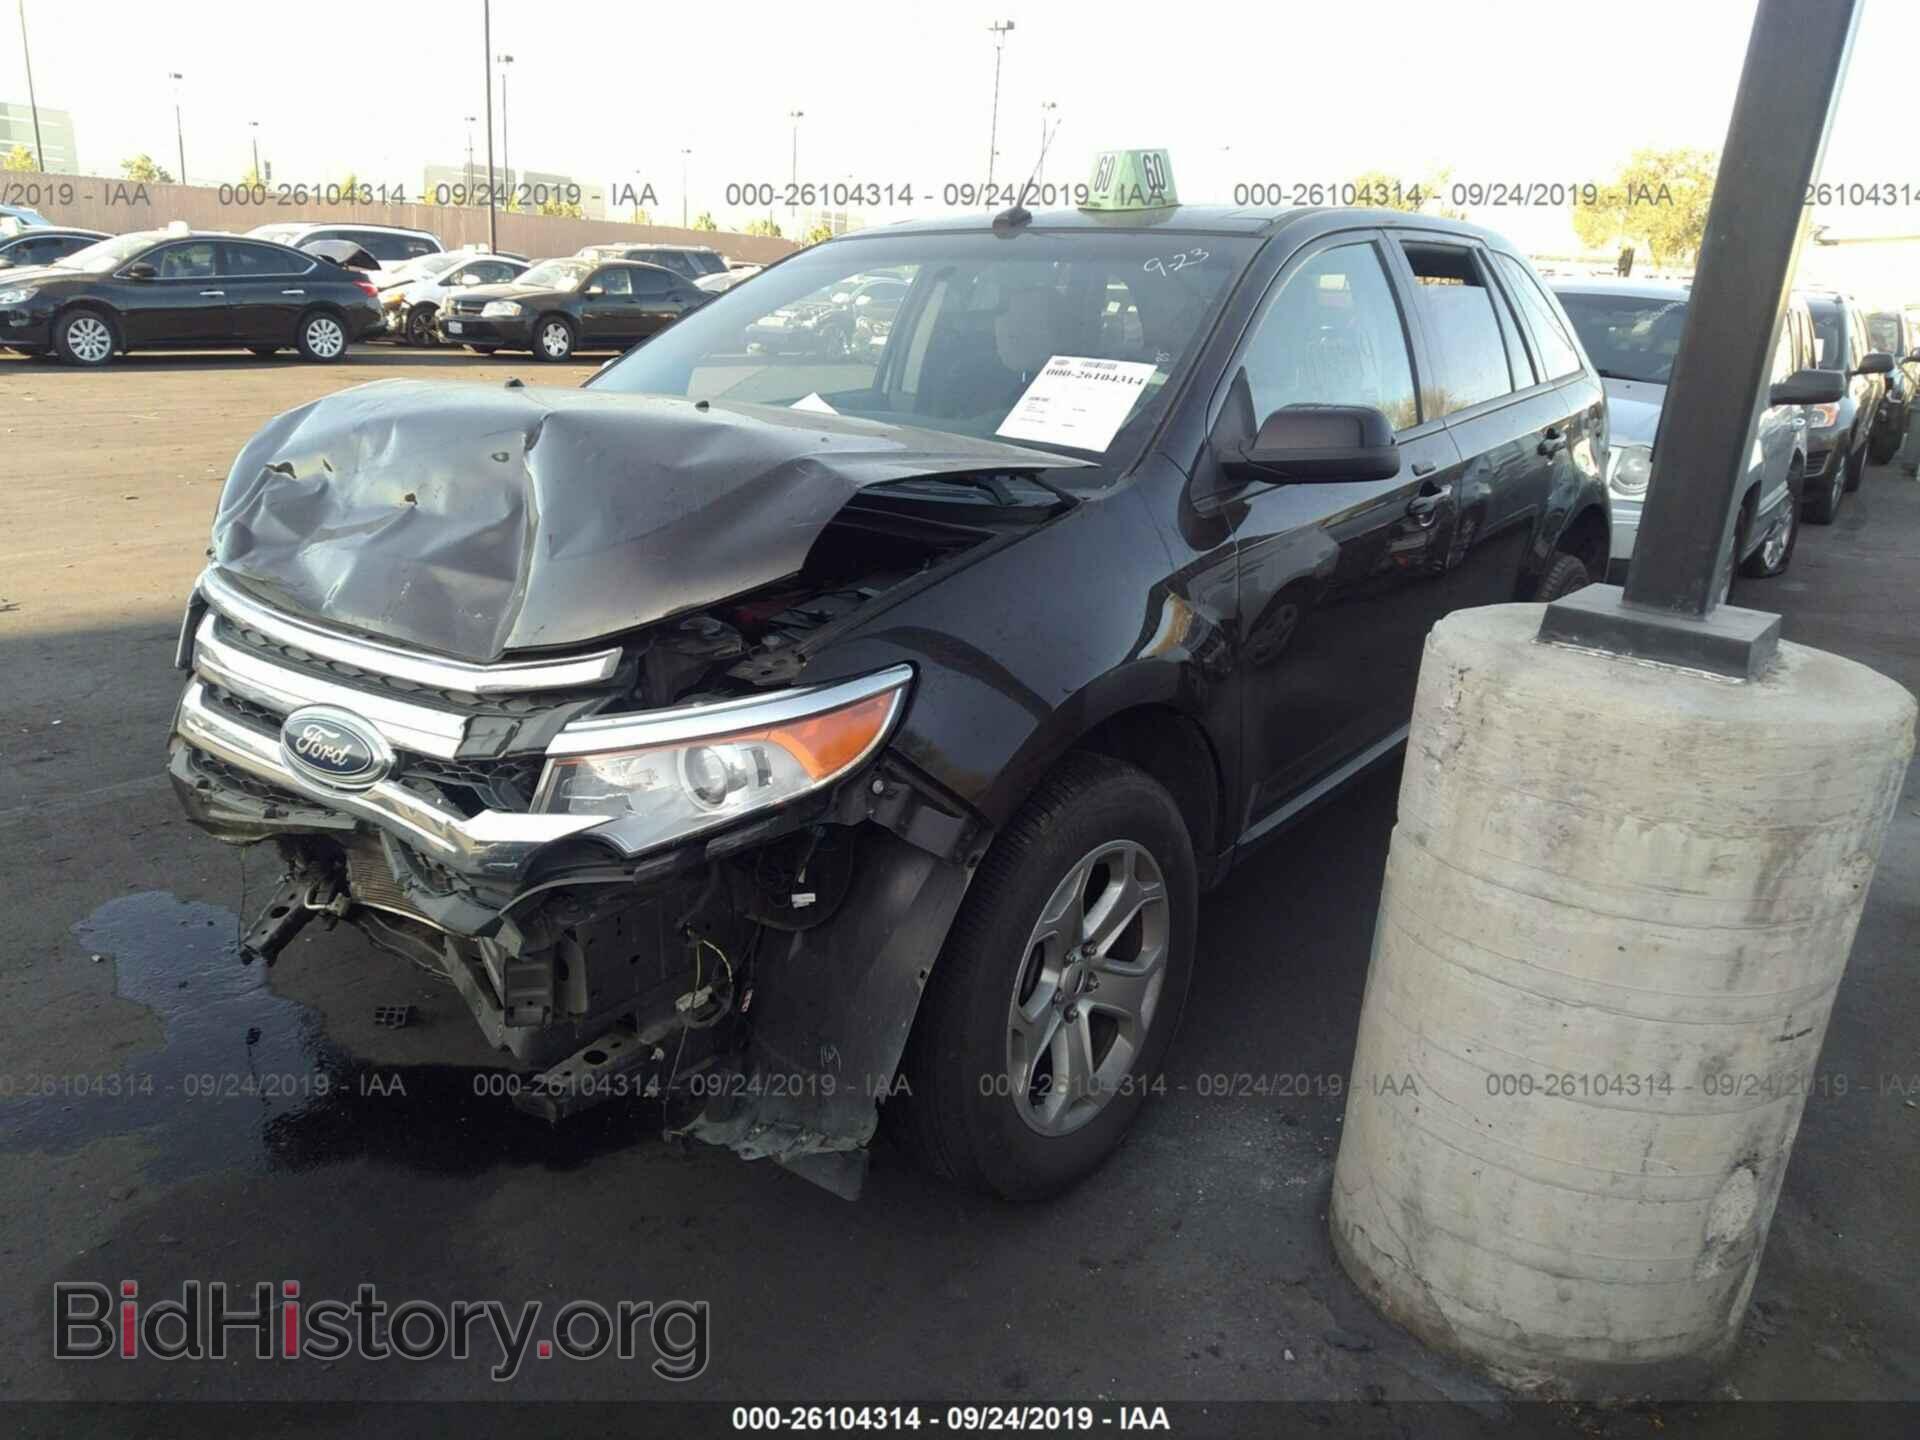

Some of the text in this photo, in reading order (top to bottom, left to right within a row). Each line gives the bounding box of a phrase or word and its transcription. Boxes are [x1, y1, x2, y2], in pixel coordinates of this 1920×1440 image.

[1095, 155, 1115, 192] 60
[1143, 153, 1166, 190] 60
[295, 724, 353, 766] Ford
